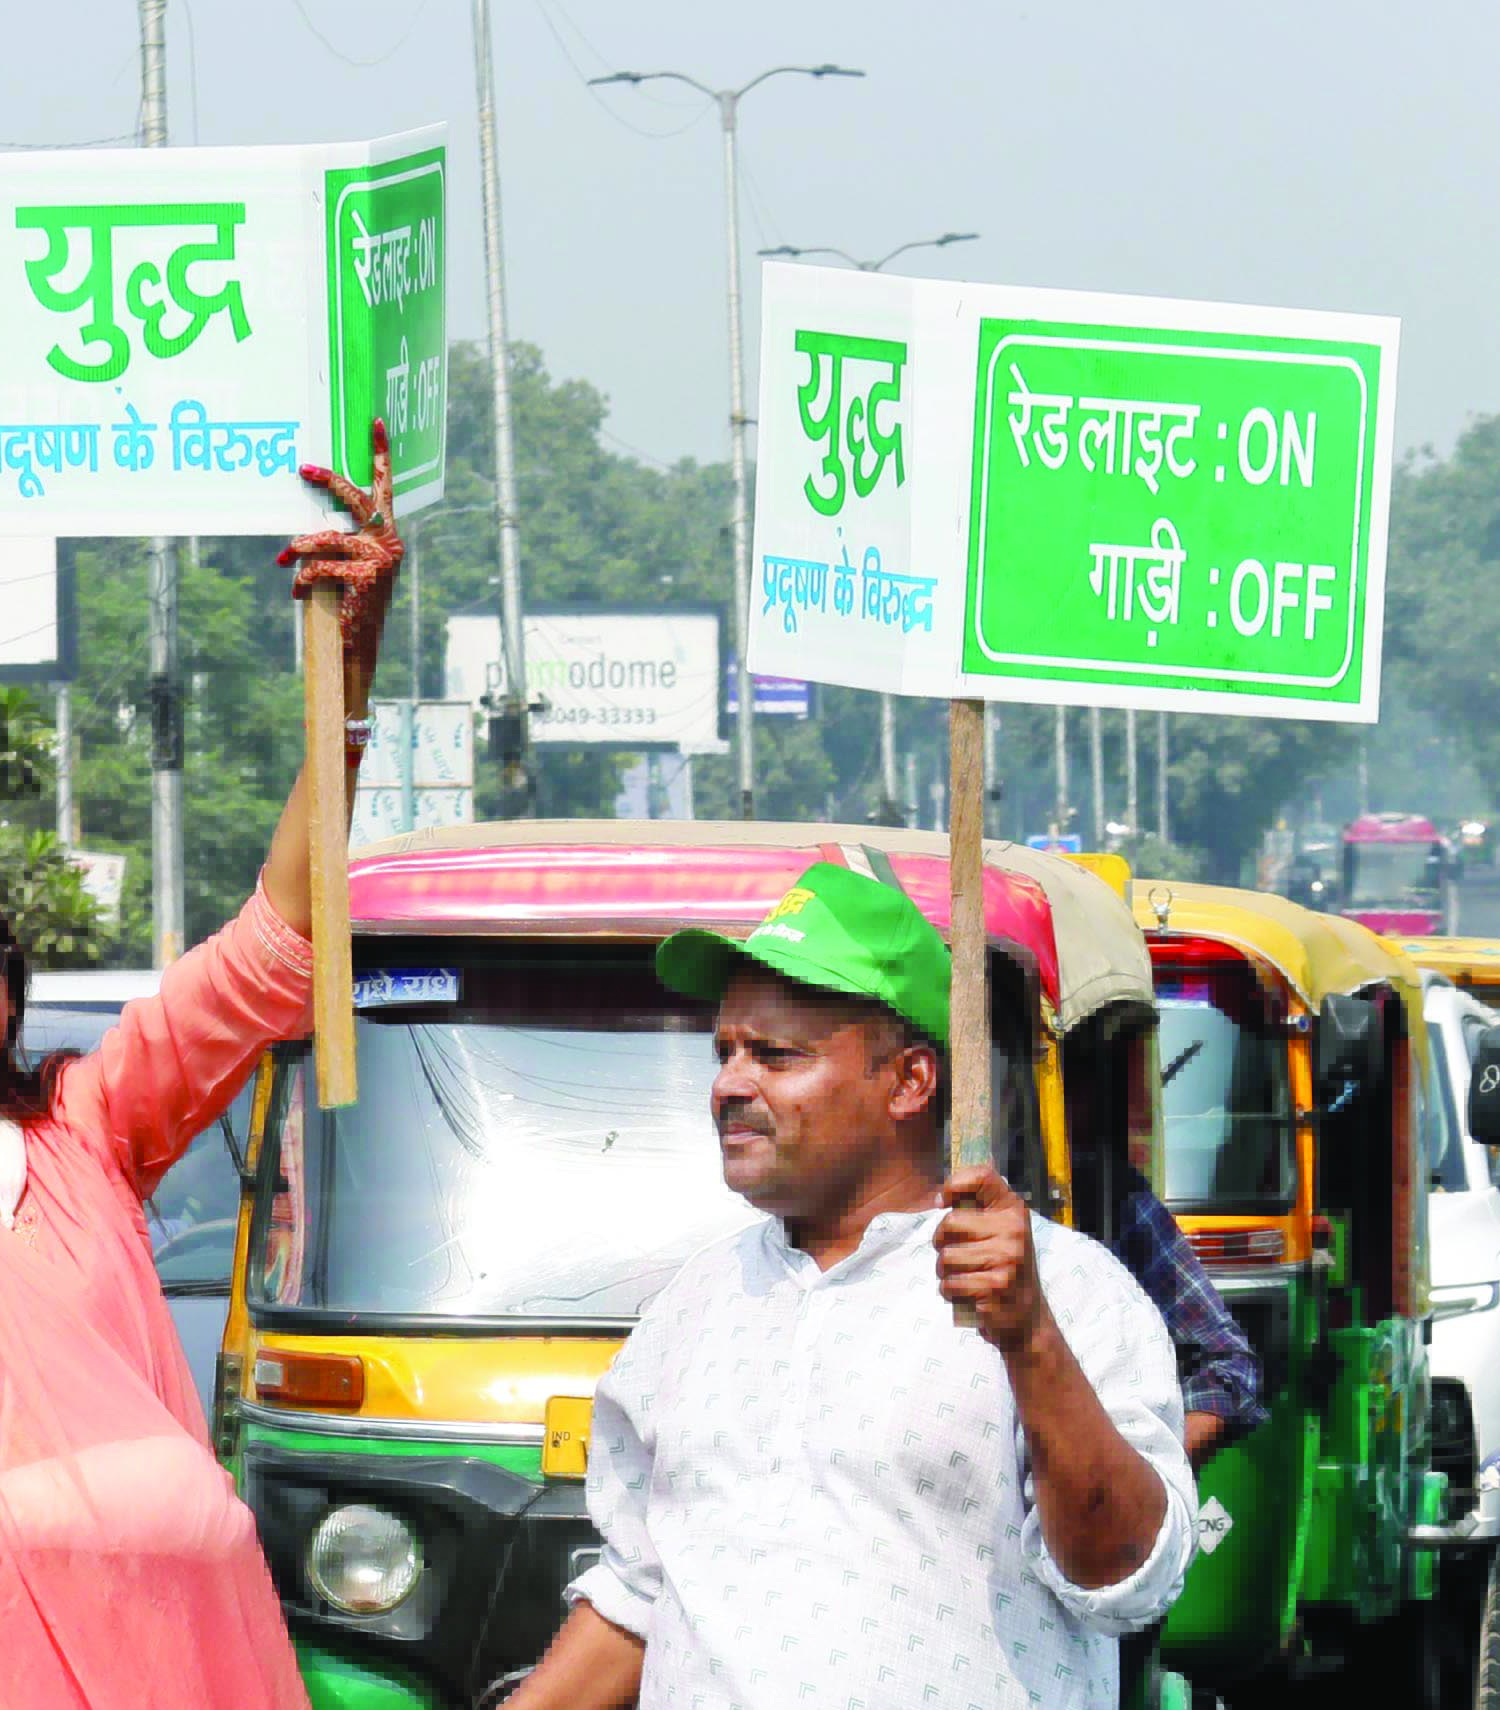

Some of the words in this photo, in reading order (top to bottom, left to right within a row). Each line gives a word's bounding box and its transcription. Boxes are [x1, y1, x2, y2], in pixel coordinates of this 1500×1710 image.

[16, 202, 252, 382] युद्ध
[111, 403, 158, 472] के
[168, 400, 301, 477] विरुद्ध
[795, 330, 907, 516] युद्ध
[762, 555, 829, 633] प्रदूषण
[834, 549, 857, 615] के
[862, 546, 938, 633] विरुद्ध
[1090, 518, 1186, 646] गाड़ी
[552, 1432, 571, 1441] IND
